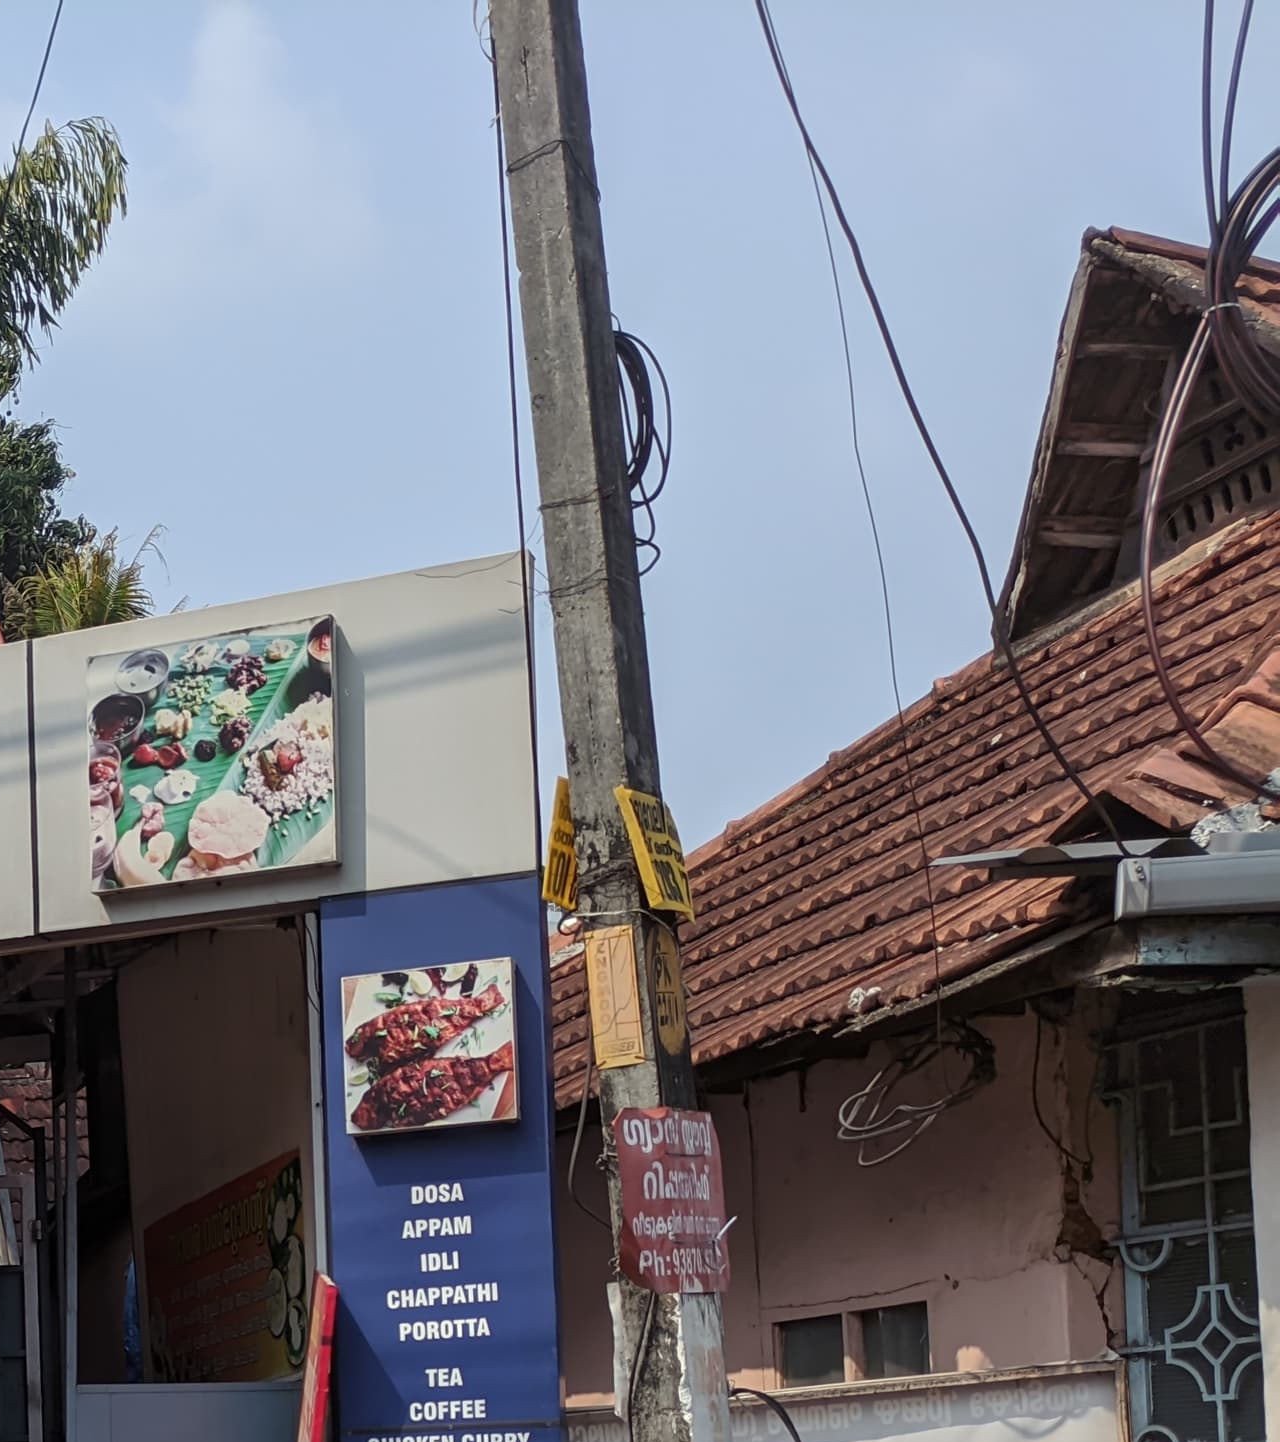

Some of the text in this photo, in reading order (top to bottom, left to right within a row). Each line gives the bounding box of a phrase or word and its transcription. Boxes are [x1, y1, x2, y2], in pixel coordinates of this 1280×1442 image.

[411, 1183, 464, 1205] DOSA
[402, 1216, 472, 1239] APPAM
[420, 1251, 460, 1272] IDLI
[639, 1249, 671, 1277] Ph:
[387, 1282, 498, 1309] CHAPPATHI
[399, 1318, 490, 1342] POROTTA
[425, 1368, 463, 1388] TEA
[409, 1399, 486, 1421] COFFEE
